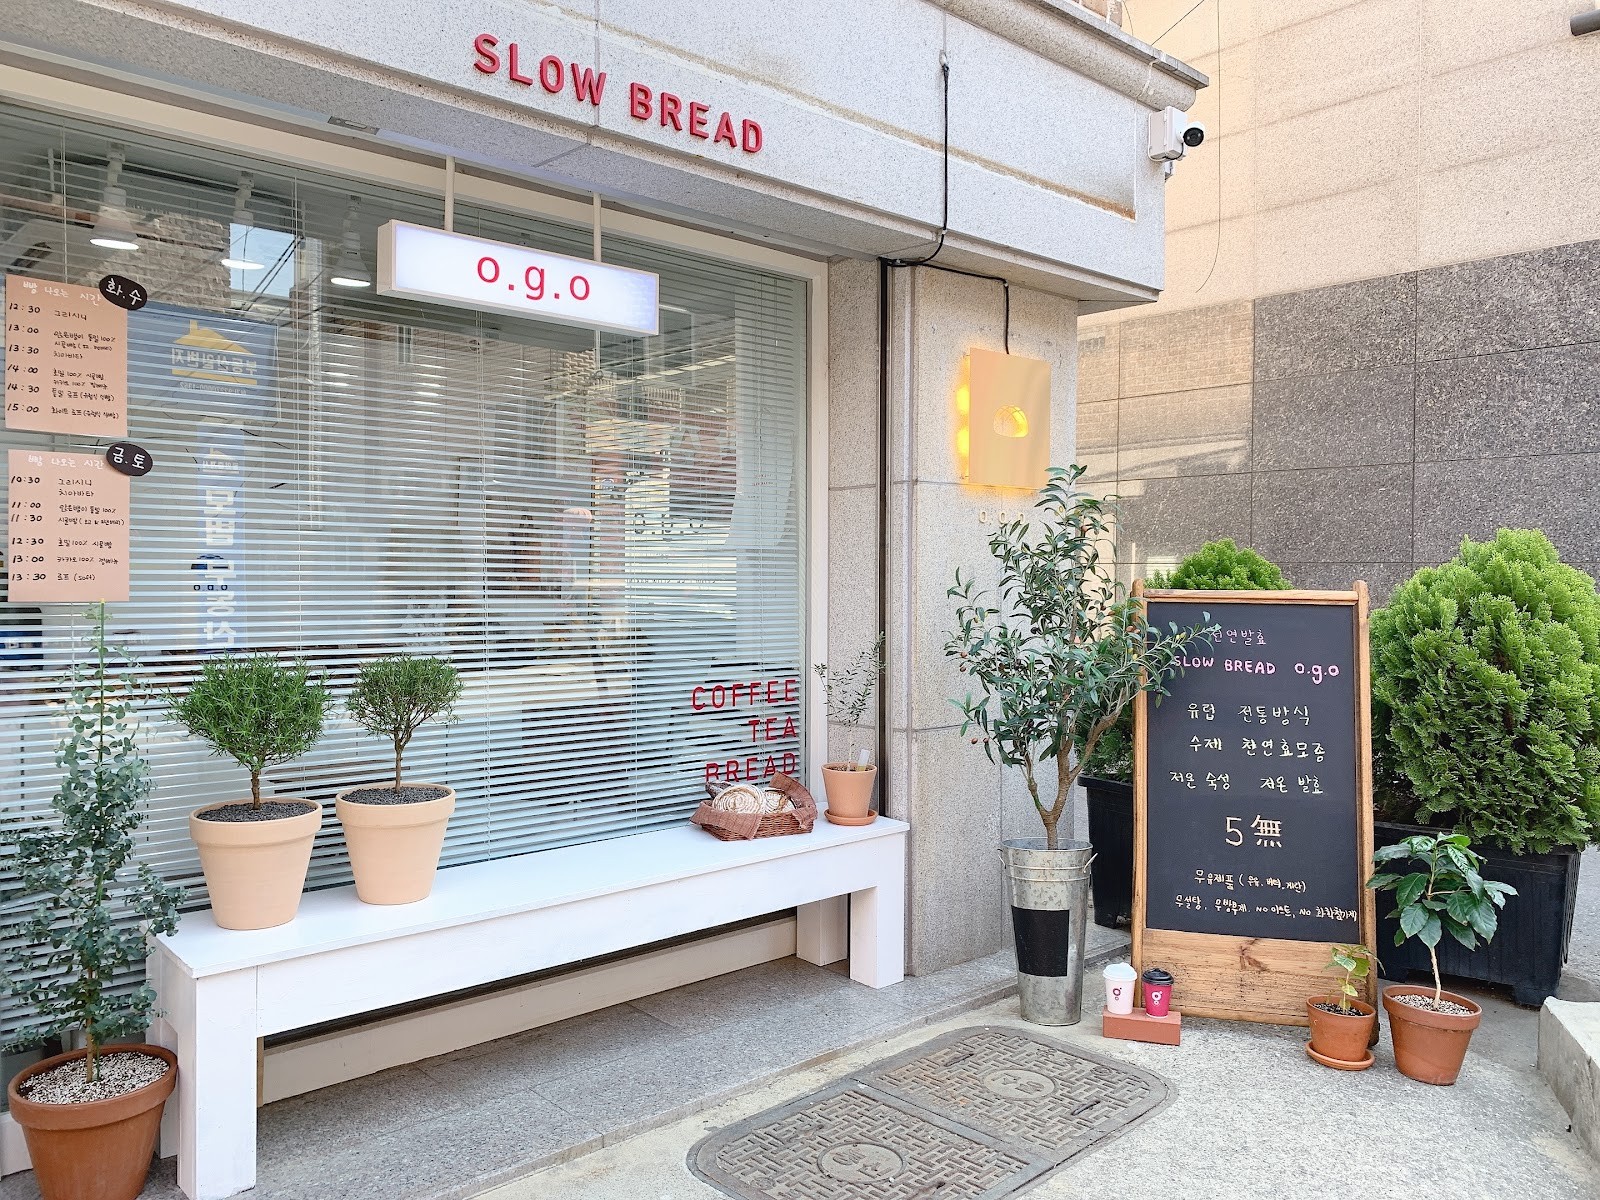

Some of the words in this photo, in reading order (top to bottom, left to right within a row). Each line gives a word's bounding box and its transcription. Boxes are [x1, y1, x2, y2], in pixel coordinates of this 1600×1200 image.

[473, 33, 607, 106] SLOW
[630, 81, 763, 154] BREAD
[477, 255, 590, 301] o.g.o
[22, 280, 39, 295] 빵
[44, 286, 69, 298] 나오는
[80, 292, 101, 306] 시간
[9, 302, 41, 314] 12:30
[54, 310, 87, 321] 그리시니
[8, 324, 39, 334] 13:00
[8, 344, 39, 355] 13:30
[7, 363, 39, 374] 14:00
[7, 382, 40, 393] 14:30
[7, 403, 40, 413] 15:00
[28, 454, 44, 467] 빵
[51, 457, 77, 468] 나오는
[84, 459, 105, 470] 시간
[11, 475, 41, 484] 10:30
[58, 478, 92, 487] 그리시니
[58, 488, 95, 497] 치아바타
[11, 501, 41, 509] 11:00
[11, 514, 43, 522] 11:30
[11, 537, 44, 545] 12:30
[12, 555, 44, 564] 13:00
[11, 573, 47, 582] 13:30
[1173, 655, 1214, 668] SLOW
[1224, 659, 1276, 675] BREAD
[1294, 662, 1340, 684] o.g.o
[692, 679, 796, 711] COFFEE
[1187, 703, 1216, 721] 유럽
[1238, 705, 1310, 726] 전통방식
[748, 716, 797, 743] TEA
[1189, 735, 1222, 752] 수제
[1241, 737, 1326, 763] 천연효모종
[705, 752, 796, 783] BREAD
[1169, 771, 1197, 790] 저온
[1205, 771, 1231, 791] 숙성
[1260, 776, 1288, 794] 저온
[1298, 774, 1324, 795] 발효
